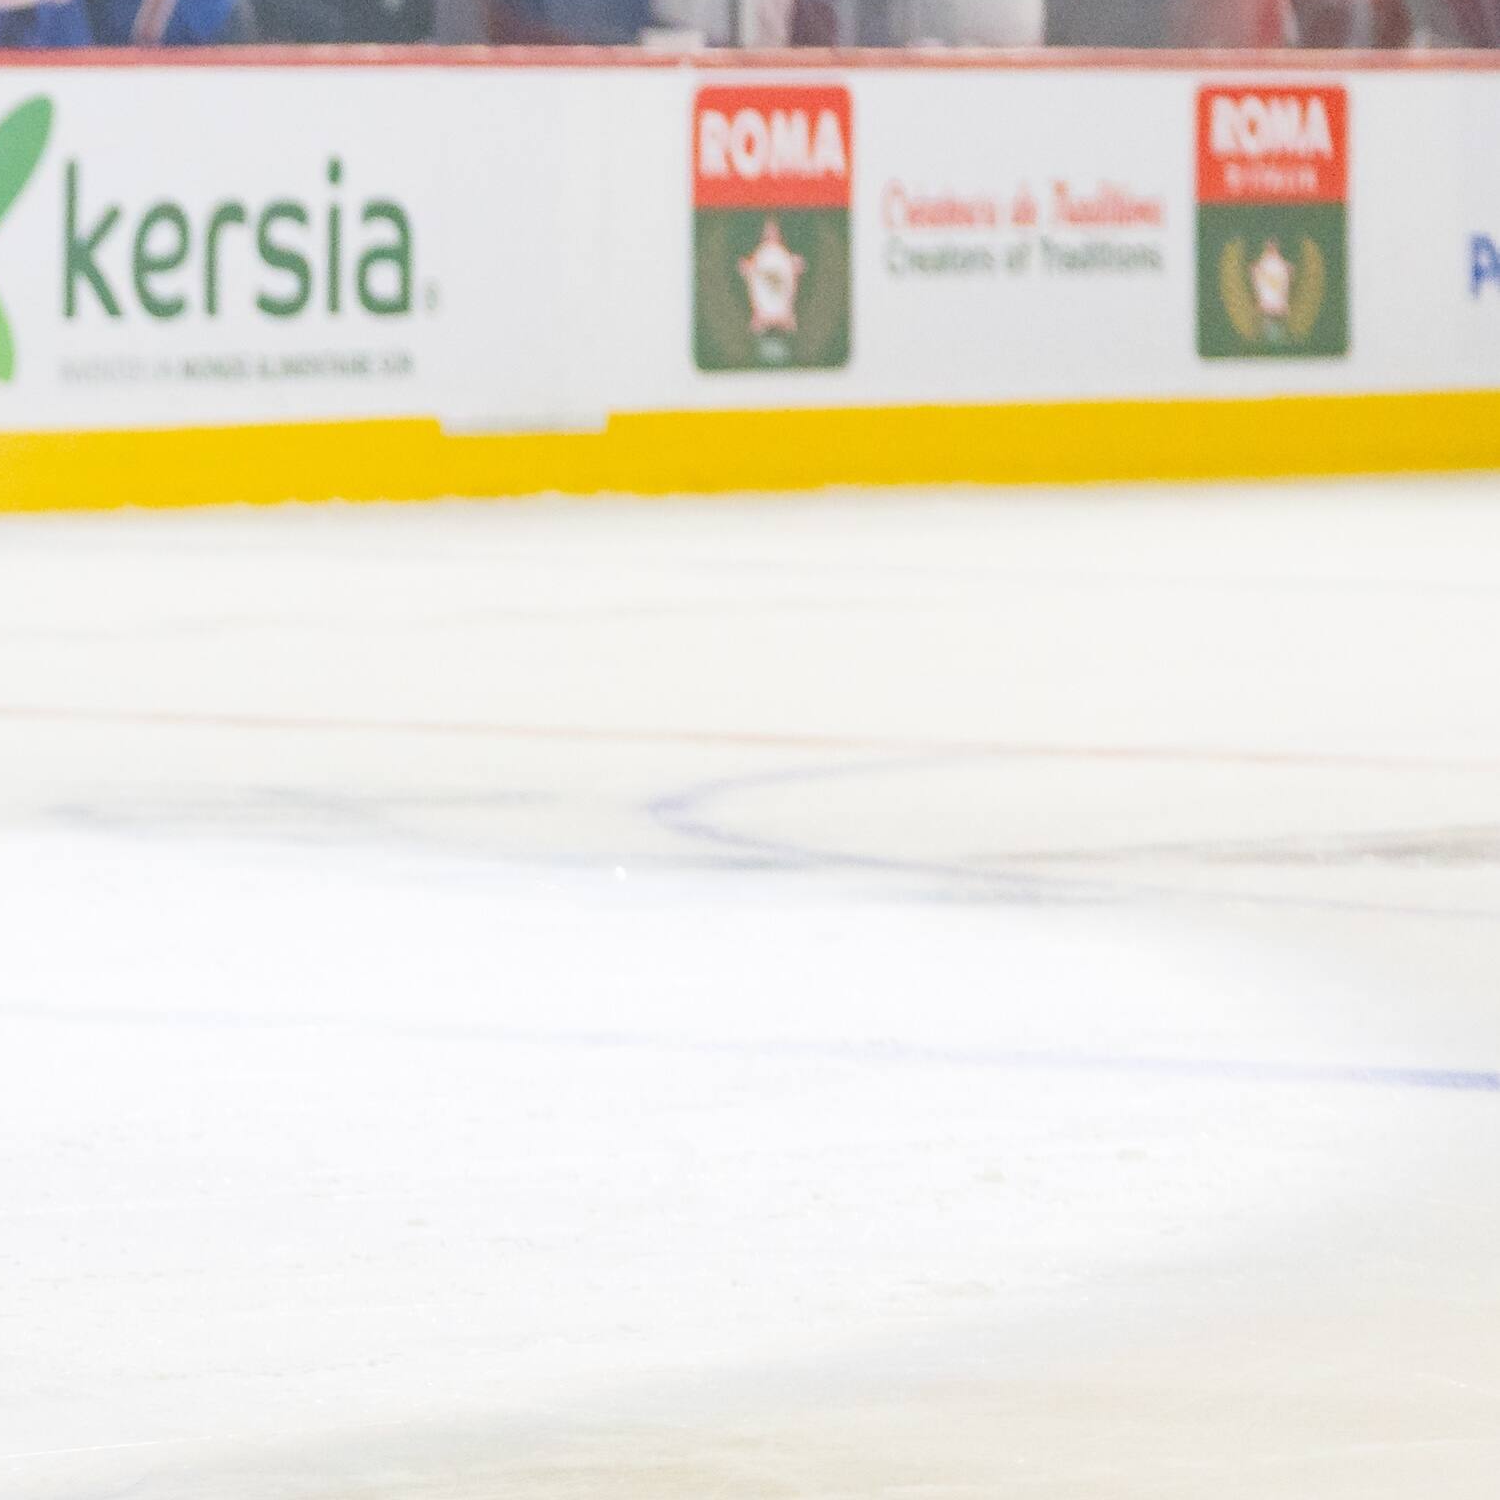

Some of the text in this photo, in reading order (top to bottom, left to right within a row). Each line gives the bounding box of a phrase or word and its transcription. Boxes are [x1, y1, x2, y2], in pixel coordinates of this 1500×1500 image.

[699, 107, 847, 179] ROMA
[1209, 94, 1333, 158] ROMA
[61, 155, 416, 321] kersia
